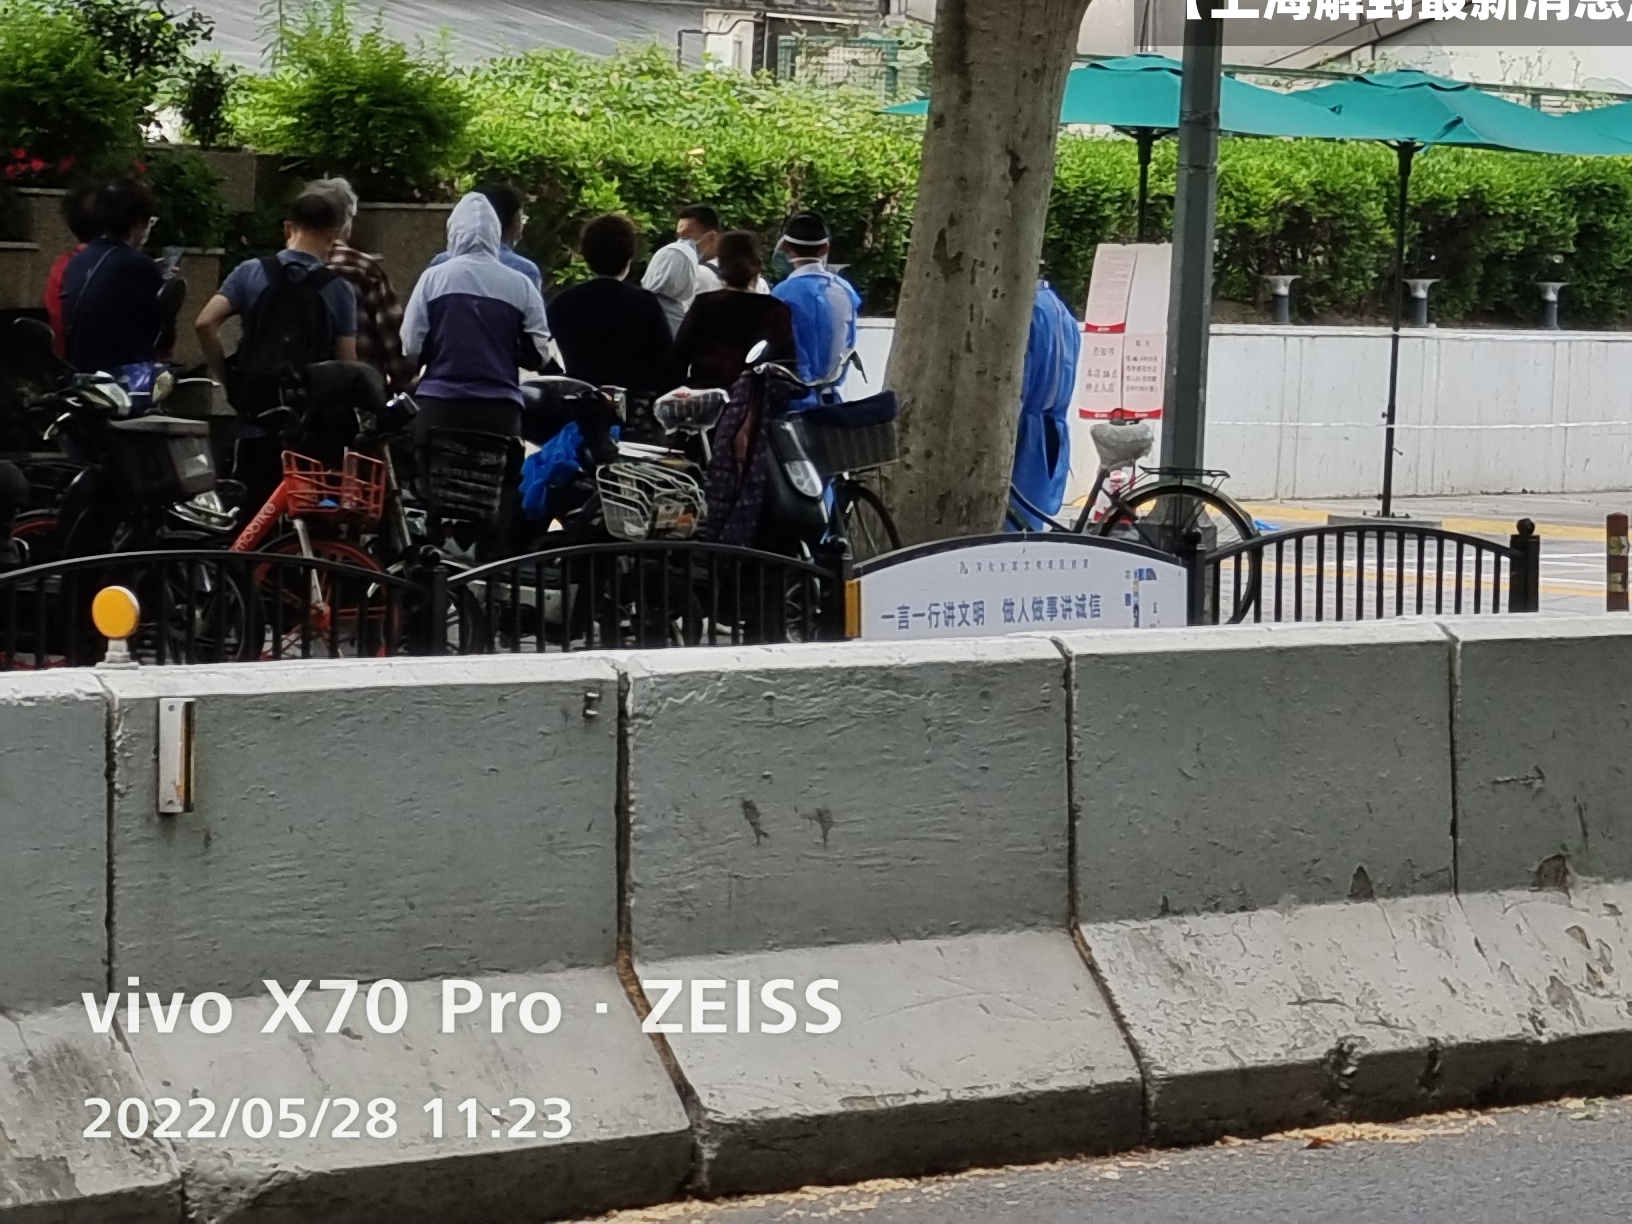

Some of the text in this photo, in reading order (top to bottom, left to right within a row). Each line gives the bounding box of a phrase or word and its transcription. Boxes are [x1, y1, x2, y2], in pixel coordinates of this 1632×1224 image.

[881, 599, 986, 631] 一言一行讲文明
[1001, 593, 1102, 624] 做人做事讲诚信
